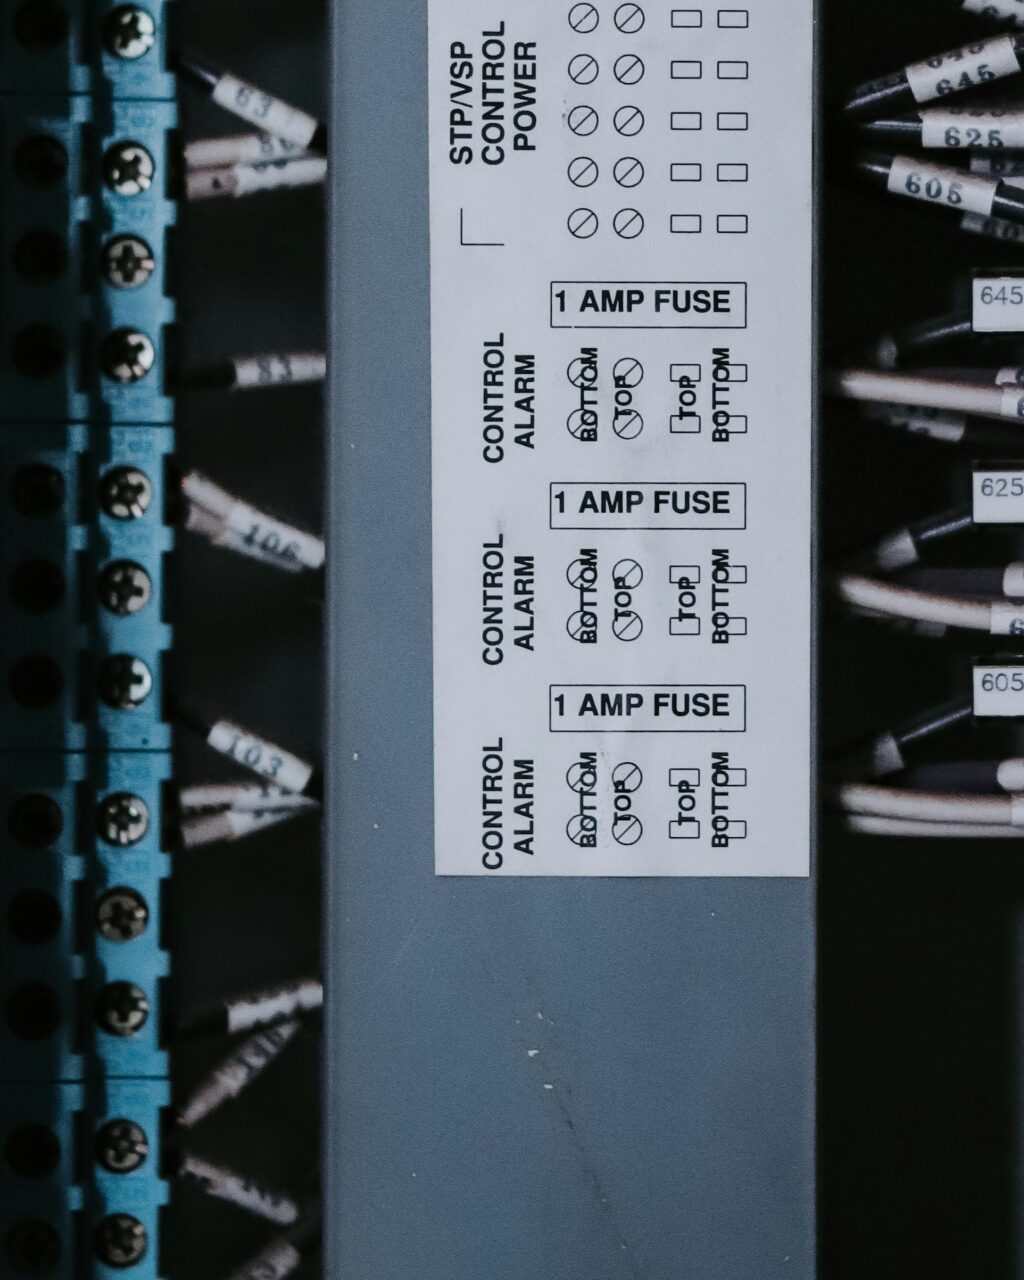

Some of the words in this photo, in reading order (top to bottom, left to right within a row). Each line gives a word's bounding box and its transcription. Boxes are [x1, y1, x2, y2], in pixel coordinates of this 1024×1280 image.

[450, 42, 473, 164] STP/VSP
[482, 21, 505, 165] CONTROL
[513, 42, 536, 150] POWER
[935, 63, 996, 97] 645
[905, 172, 962, 205] 605
[554, 290, 567, 313] 1
[580, 290, 644, 312] AMP
[655, 290, 730, 313] FUSE
[981, 286, 1023, 304] 645
[483, 333, 504, 463] CONTROL
[514, 355, 534, 449] ALARM
[580, 347, 598, 443] BOTTOM
[614, 375, 631, 418] TOP
[679, 375, 696, 418] TOP
[711, 347, 730, 443] BOTTOM
[554, 491, 567, 514] 1
[579, 491, 643, 513] AMP
[654, 491, 730, 514] FUSE
[981, 478, 1024, 497] 625
[482, 534, 503, 665] CONTROL
[514, 556, 534, 651] ALARM
[580, 548, 598, 644] BOTTOM
[614, 576, 631, 621] TOP
[679, 576, 696, 621] TOP
[711, 548, 730, 644] BOTTOM
[554, 693, 567, 716] 1
[579, 694, 643, 716] AMP
[654, 693, 729, 716] FUSE
[982, 673, 1024, 691] 605
[482, 737, 503, 869] CONTROL
[514, 760, 533, 855] ALARM
[580, 751, 598, 848] BOTTOM
[614, 779, 631, 824] TOP
[679, 779, 696, 824] TOP
[711, 751, 730, 848] BOTTOM
